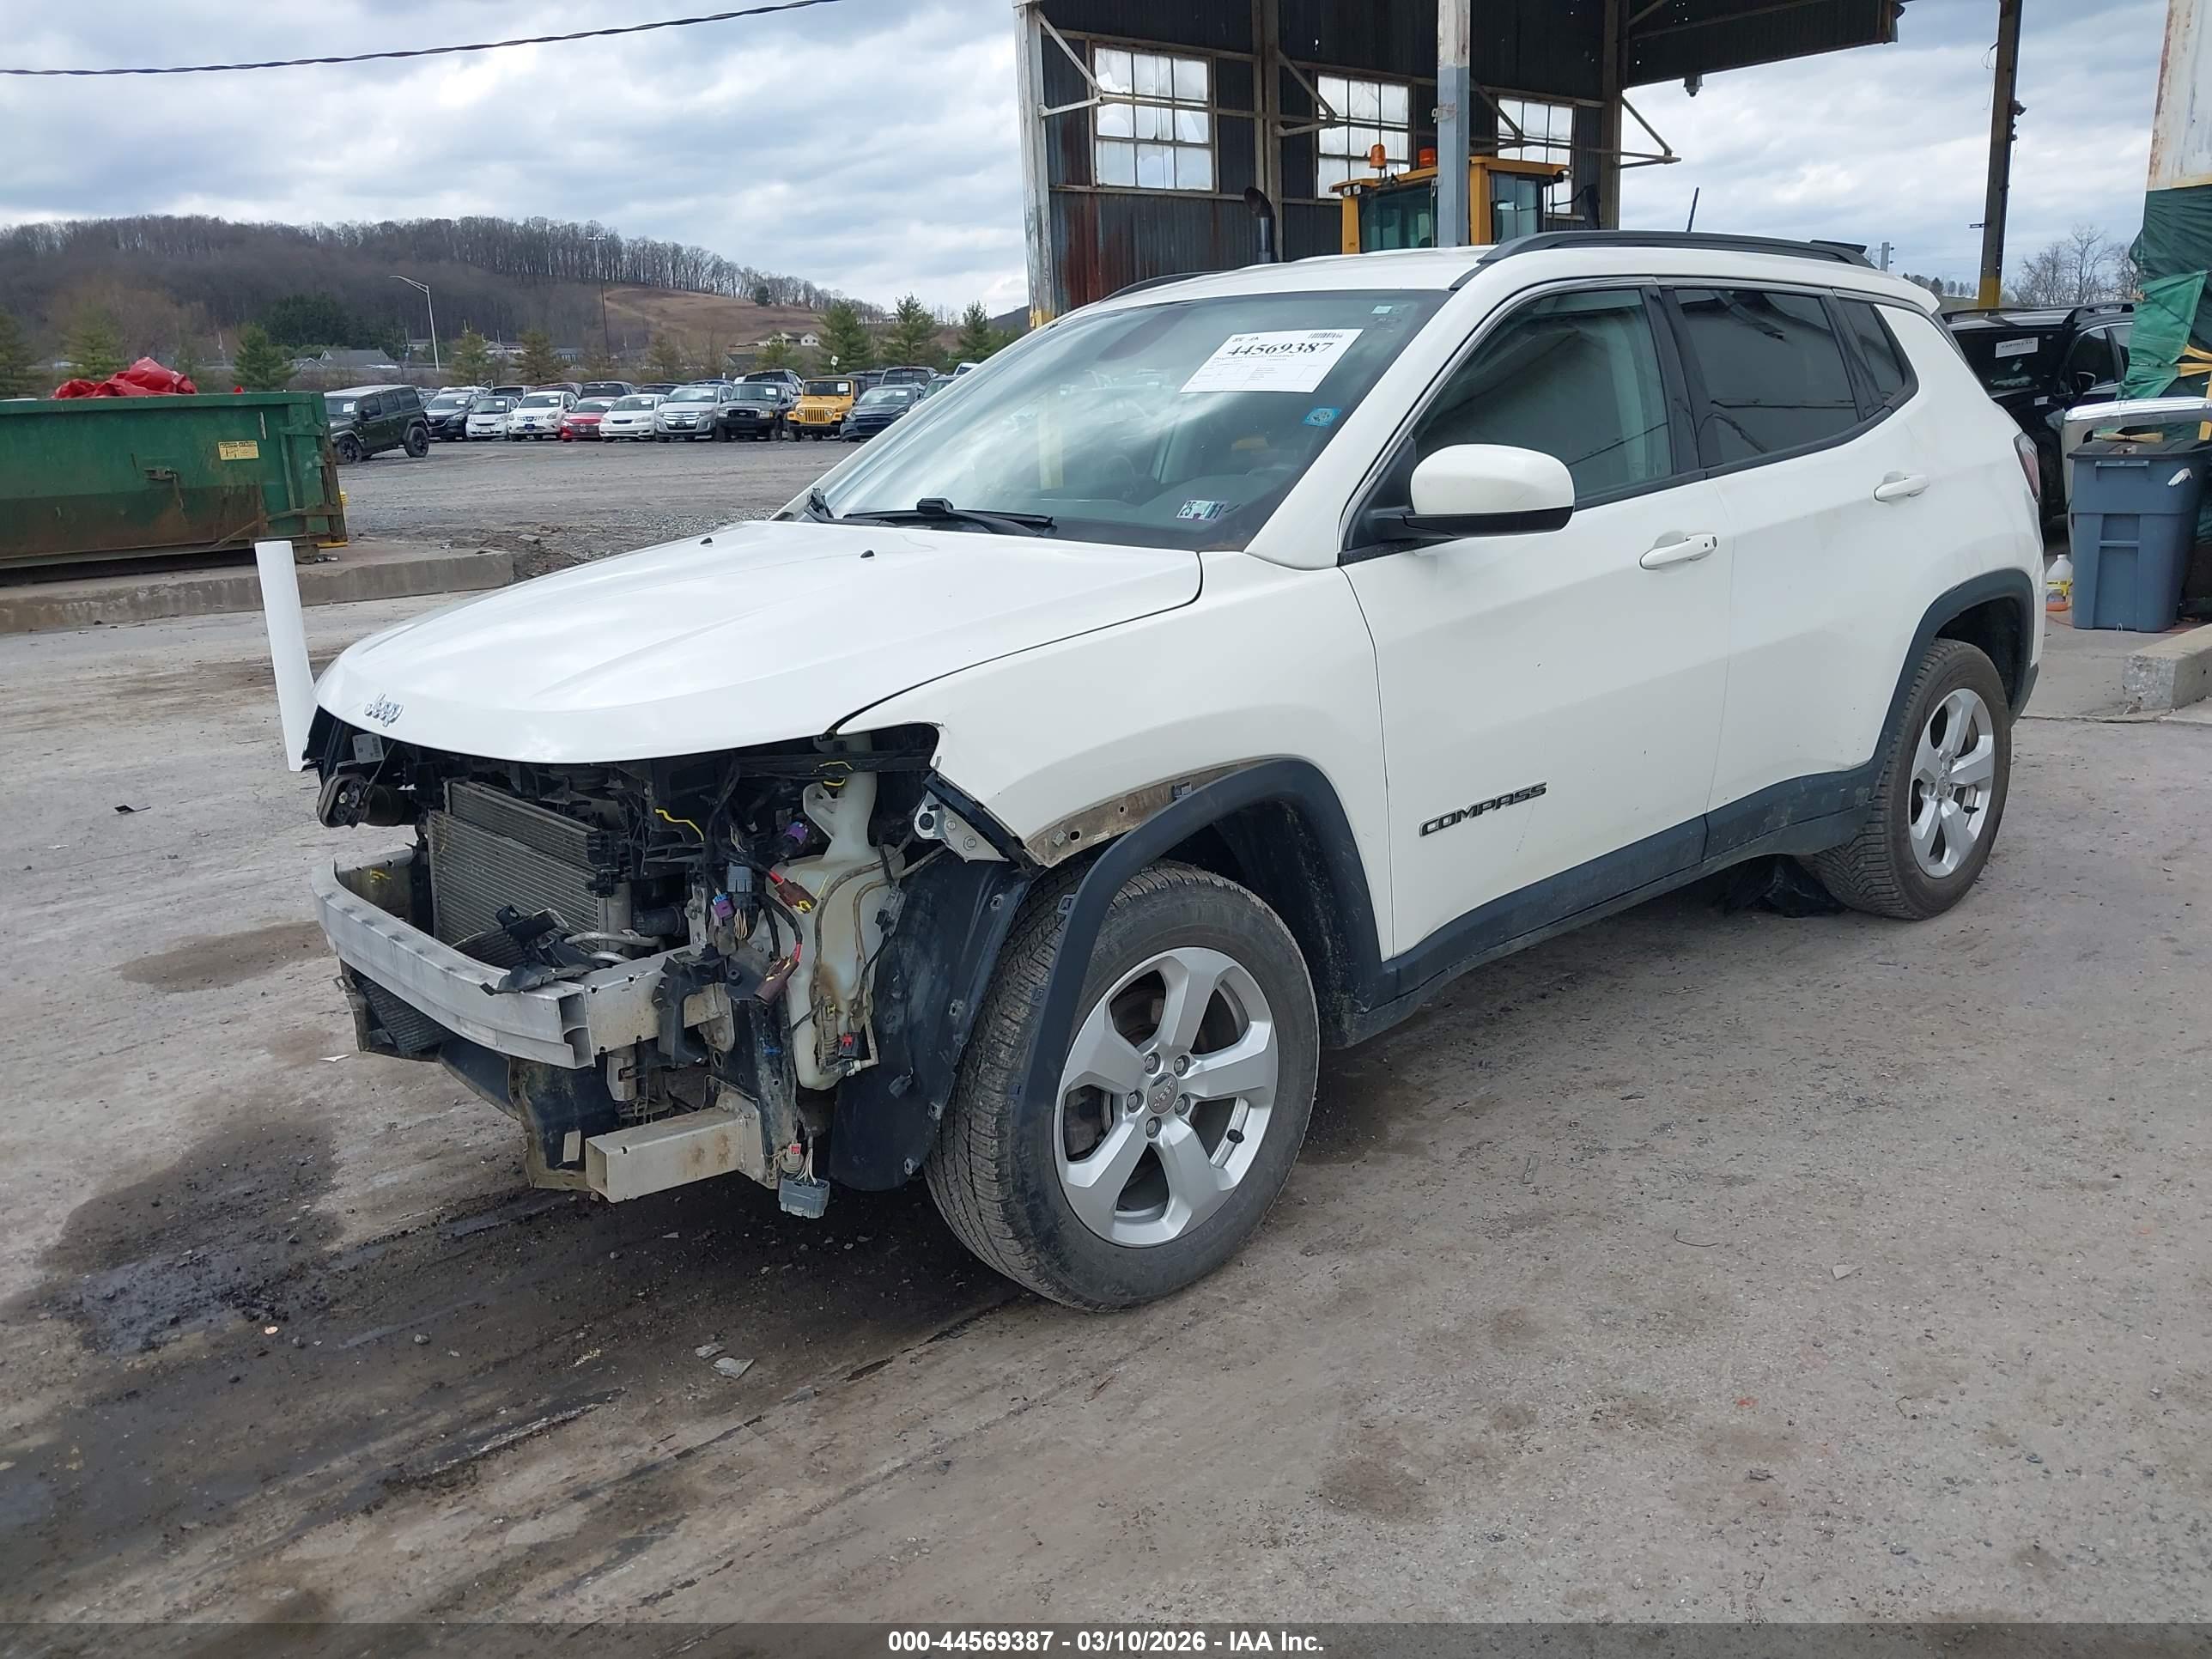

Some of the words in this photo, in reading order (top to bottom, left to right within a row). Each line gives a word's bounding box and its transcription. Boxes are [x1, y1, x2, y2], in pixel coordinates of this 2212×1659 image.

[1227, 342, 1334, 356] 44569387
[363, 693, 404, 727] Jeep
[1419, 781, 1547, 837] COMPASS
